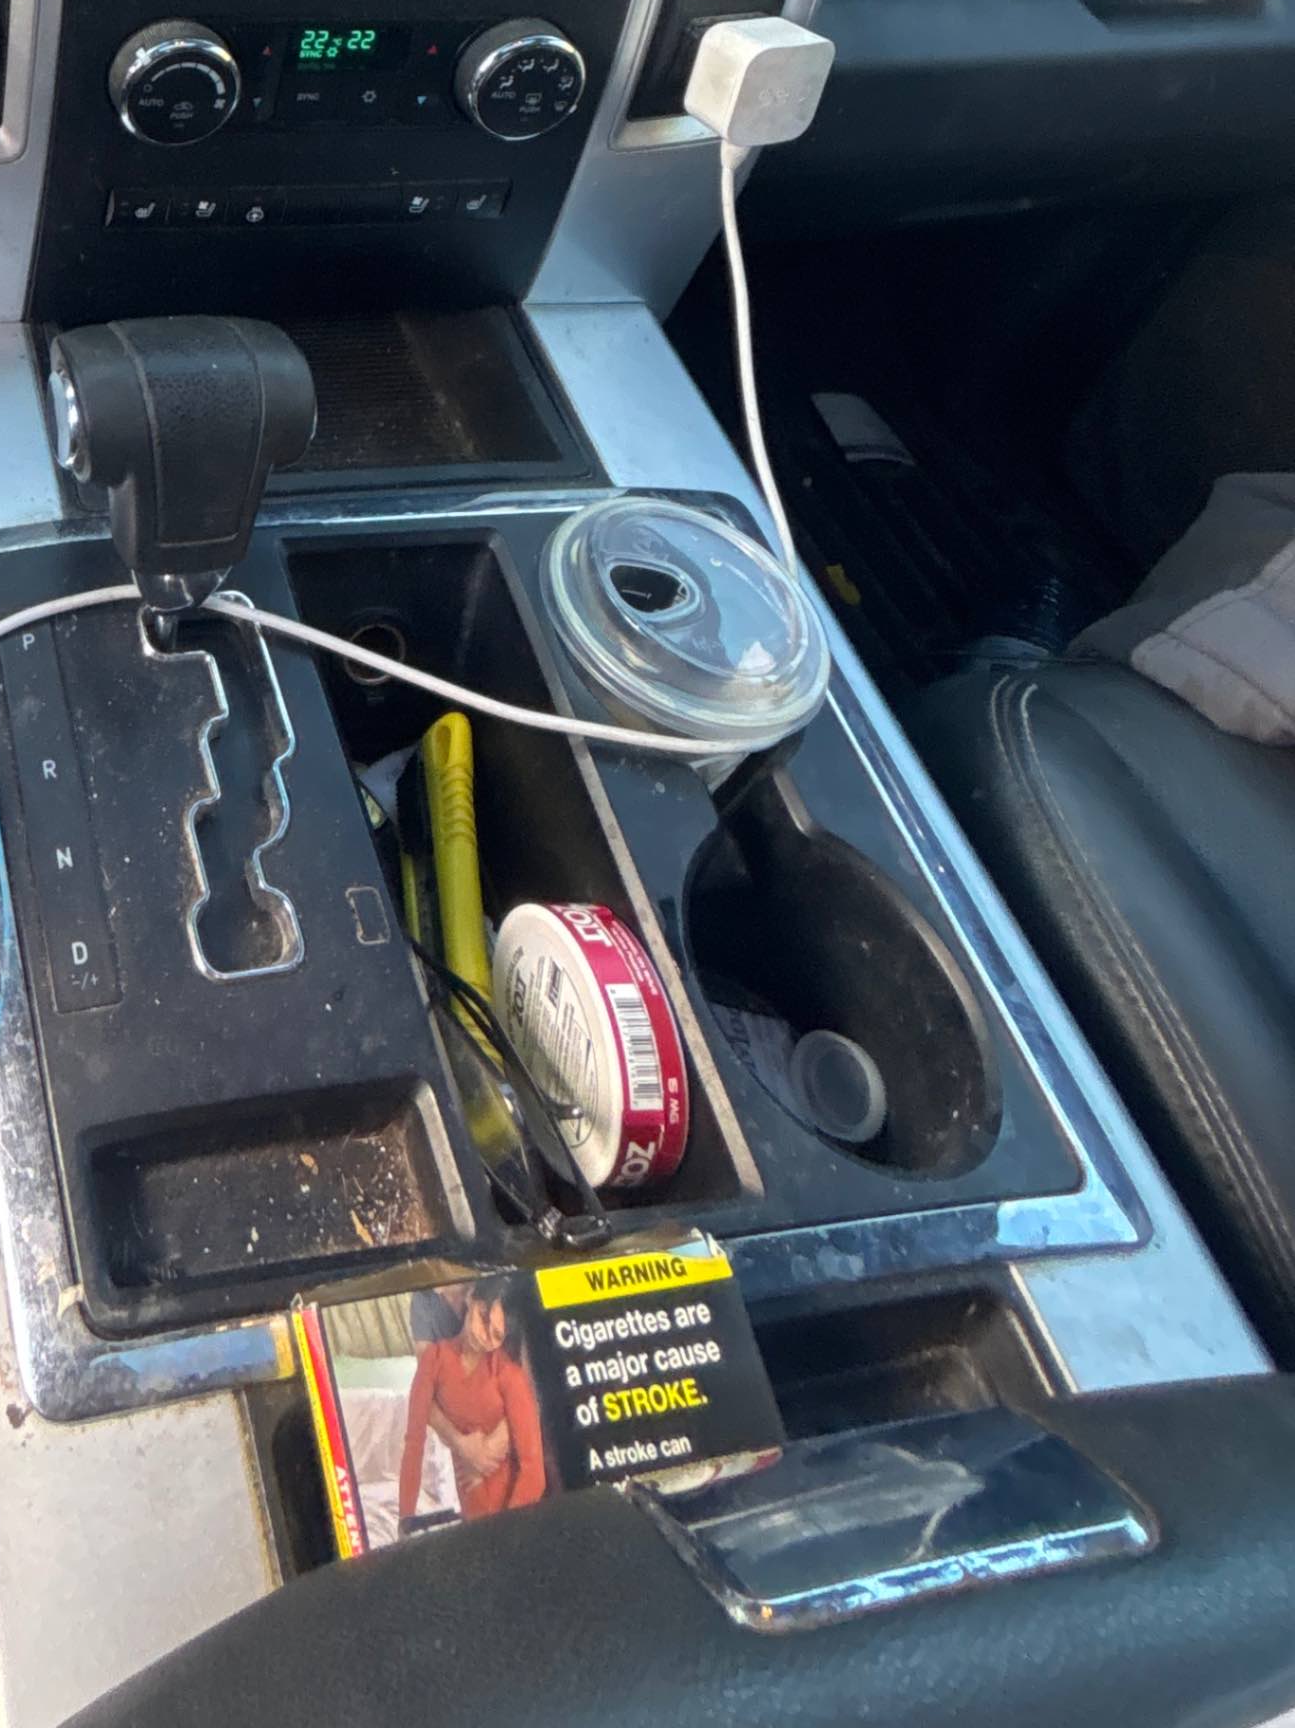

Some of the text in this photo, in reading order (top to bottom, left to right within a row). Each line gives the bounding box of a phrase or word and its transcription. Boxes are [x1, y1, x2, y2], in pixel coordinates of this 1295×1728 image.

[301, 30, 329, 49] 22
[347, 30, 376, 50] 22
[22, 633, 35, 651] P
[42, 759, 57, 779] R
[56, 847, 73, 869] N
[71, 941, 88, 965] D
[585, 1257, 687, 1292] WARNING
[555, 1301, 711, 1349] Cigarettes are
[566, 1340, 722, 1388] a major cause
[576, 1378, 709, 1428] of STROKE.
[589, 1434, 692, 1472] A stroke can
